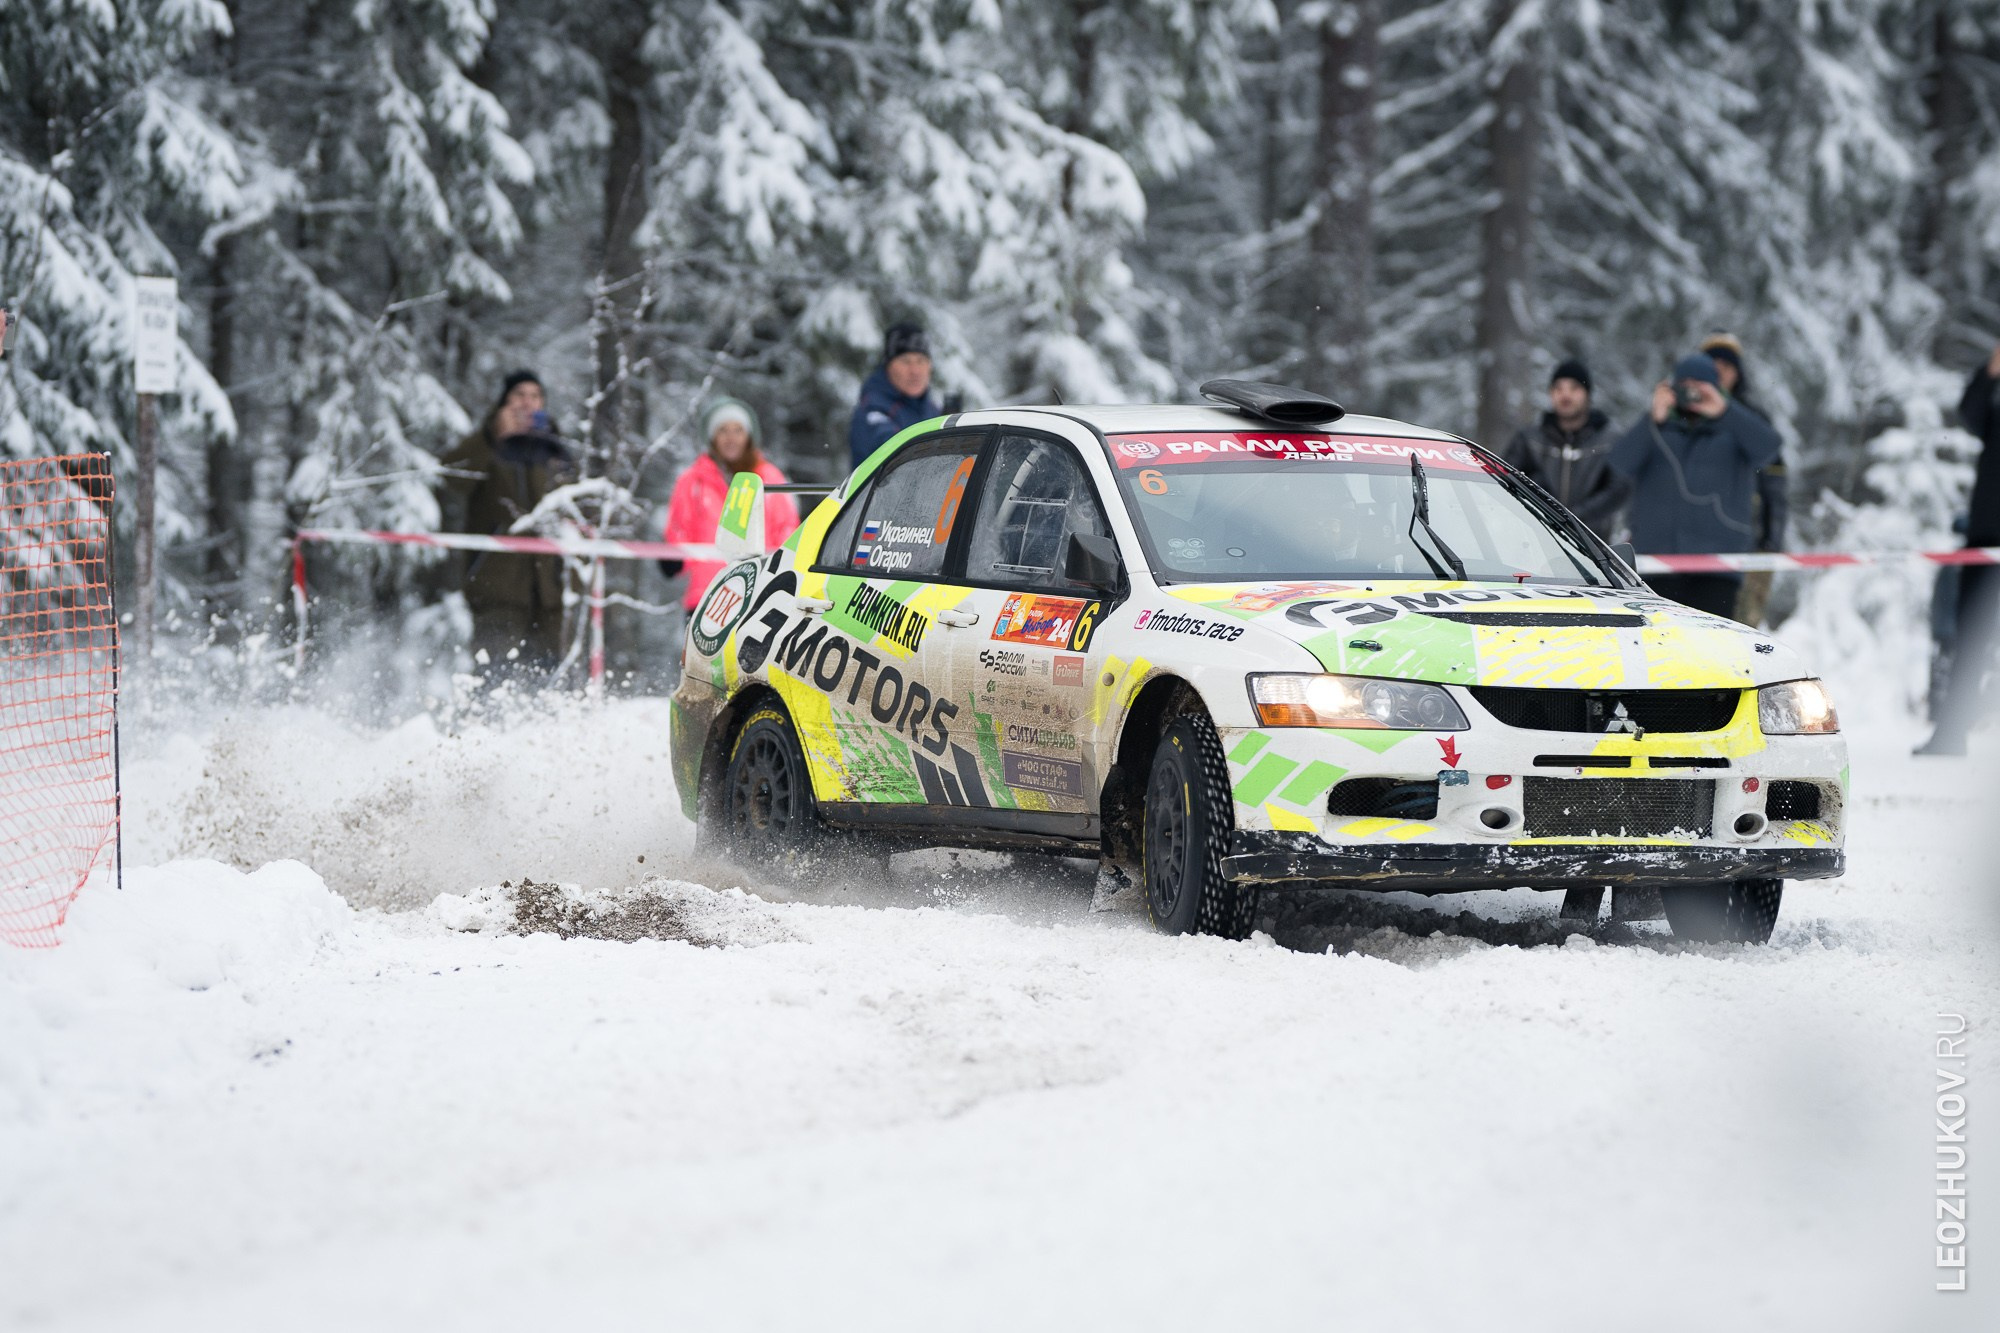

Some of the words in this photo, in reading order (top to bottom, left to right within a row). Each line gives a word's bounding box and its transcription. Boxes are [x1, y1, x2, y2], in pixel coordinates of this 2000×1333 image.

[1166, 439, 1297, 455] РАЛЛИ
[1303, 440, 1446, 461] РОССИИ
[1138, 469, 1168, 495] 6
[934, 456, 975, 544] 6
[878, 520, 934, 548] Украинец
[870, 545, 912, 573] Огарко
[845, 582, 928, 653] PRIMKON.RU
[1047, 617, 1073, 642] 24
[1073, 602, 1100, 651] 6
[993, 662, 1027, 677] РОССИИ
